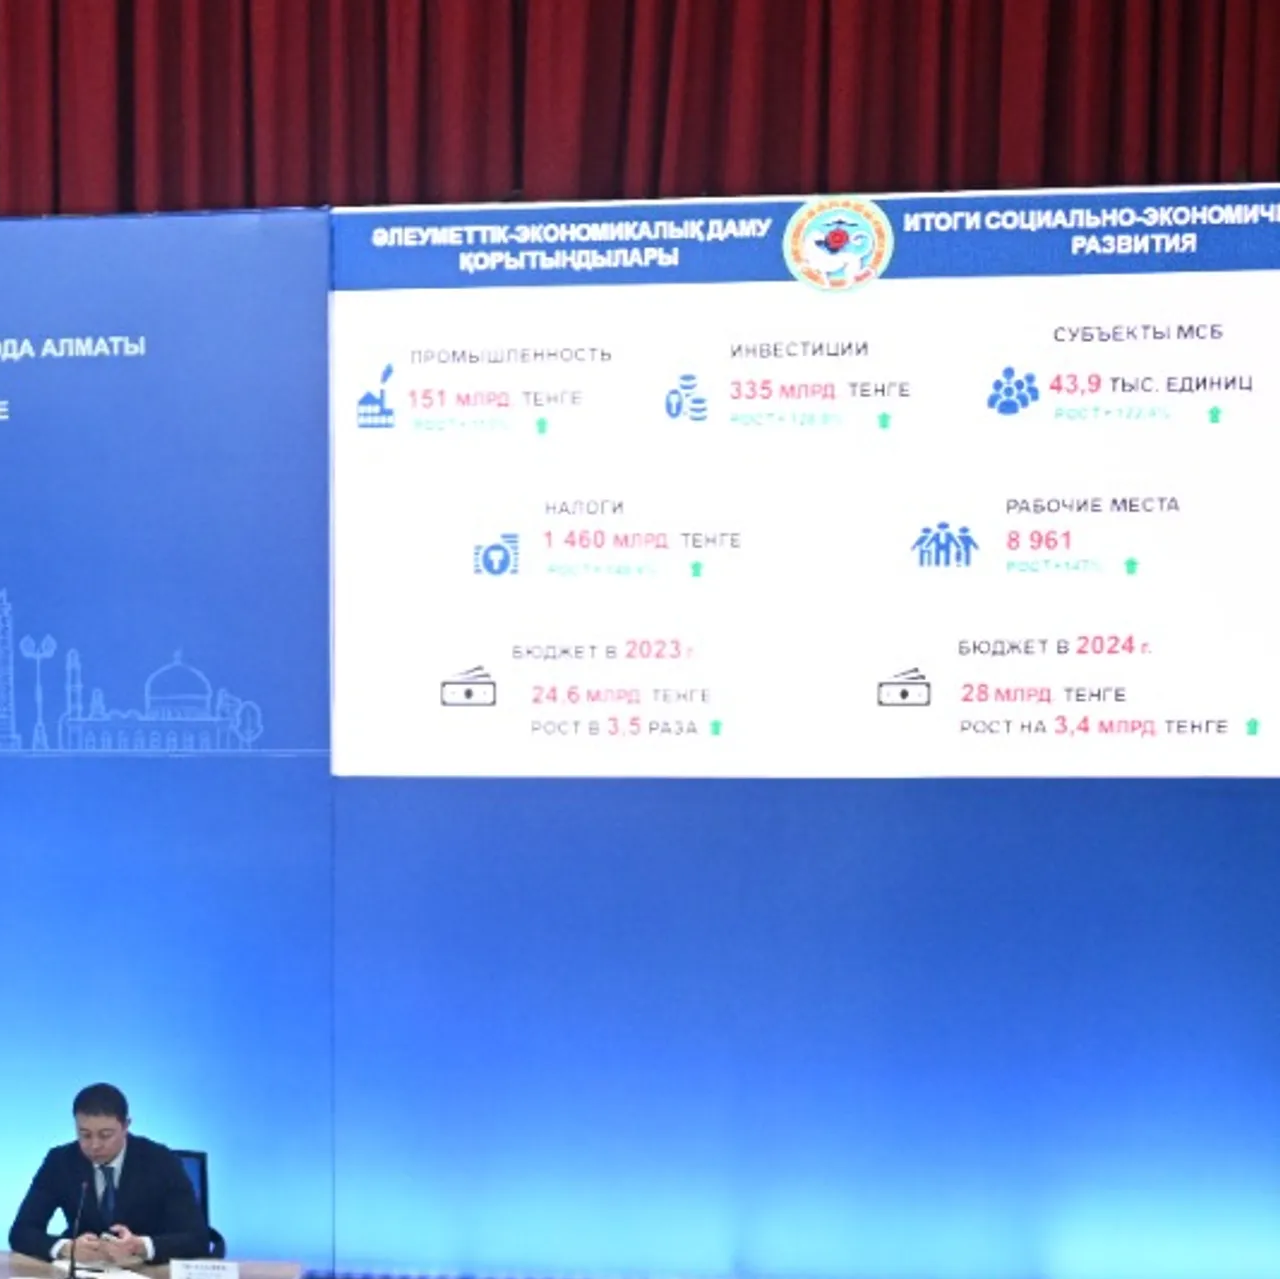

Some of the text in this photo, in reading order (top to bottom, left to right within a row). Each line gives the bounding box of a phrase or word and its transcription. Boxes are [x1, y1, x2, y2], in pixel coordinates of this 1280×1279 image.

[903, 202, 1280, 233] ИТОГИ СОЦИАЛЬНО-ЭКОНОМИЧ
[706, 217, 772, 242] ДАМУ
[1070, 232, 1197, 256] РАЗВИТИЯ
[1053, 323, 1224, 343] СУБЪЕКТЫ МСБ
[40, 335, 146, 359] АЛМАТЫ
[410, 347, 612, 365] ПРОМЫШЛЕННОСТЬ
[730, 340, 869, 360] ИНВЕСТИЦИИ
[730, 379, 773, 400] 335
[847, 382, 911, 398] ТЕНГЕ
[1049, 373, 1102, 396] 43,9
[1166, 374, 1253, 395] ЕДИНИЦ
[408, 388, 446, 409] 151
[522, 390, 583, 407] ТЕНГЕ
[545, 499, 624, 516] НАЛОГИ
[1006, 496, 1180, 515] РАБОЧИЕ МЕСТА
[564, 529, 605, 550] 460
[680, 532, 740, 549] ТЕНГЕ
[1006, 529, 1072, 551] 8 961
[512, 644, 597, 662] БЮДЖЕТ
[605, 645, 617, 660] В
[625, 639, 681, 660] 2023
[958, 638, 1048, 658] БЮДЖЕТ
[1056, 639, 1070, 656] В
[1076, 635, 1136, 656] 2024
[652, 688, 710, 705] ТЕНГЕ
[961, 682, 990, 703] 28
[1064, 686, 1127, 703] ТЕНГЕ
[531, 720, 581, 736] РОСТ
[588, 720, 600, 736] В
[648, 720, 698, 736] РАЗА
[959, 719, 1012, 735] РОСТ
[1020, 719, 1047, 735] НА
[1054, 714, 1090, 737] 3,4
[1165, 718, 1229, 735] ТЕНГЕ
